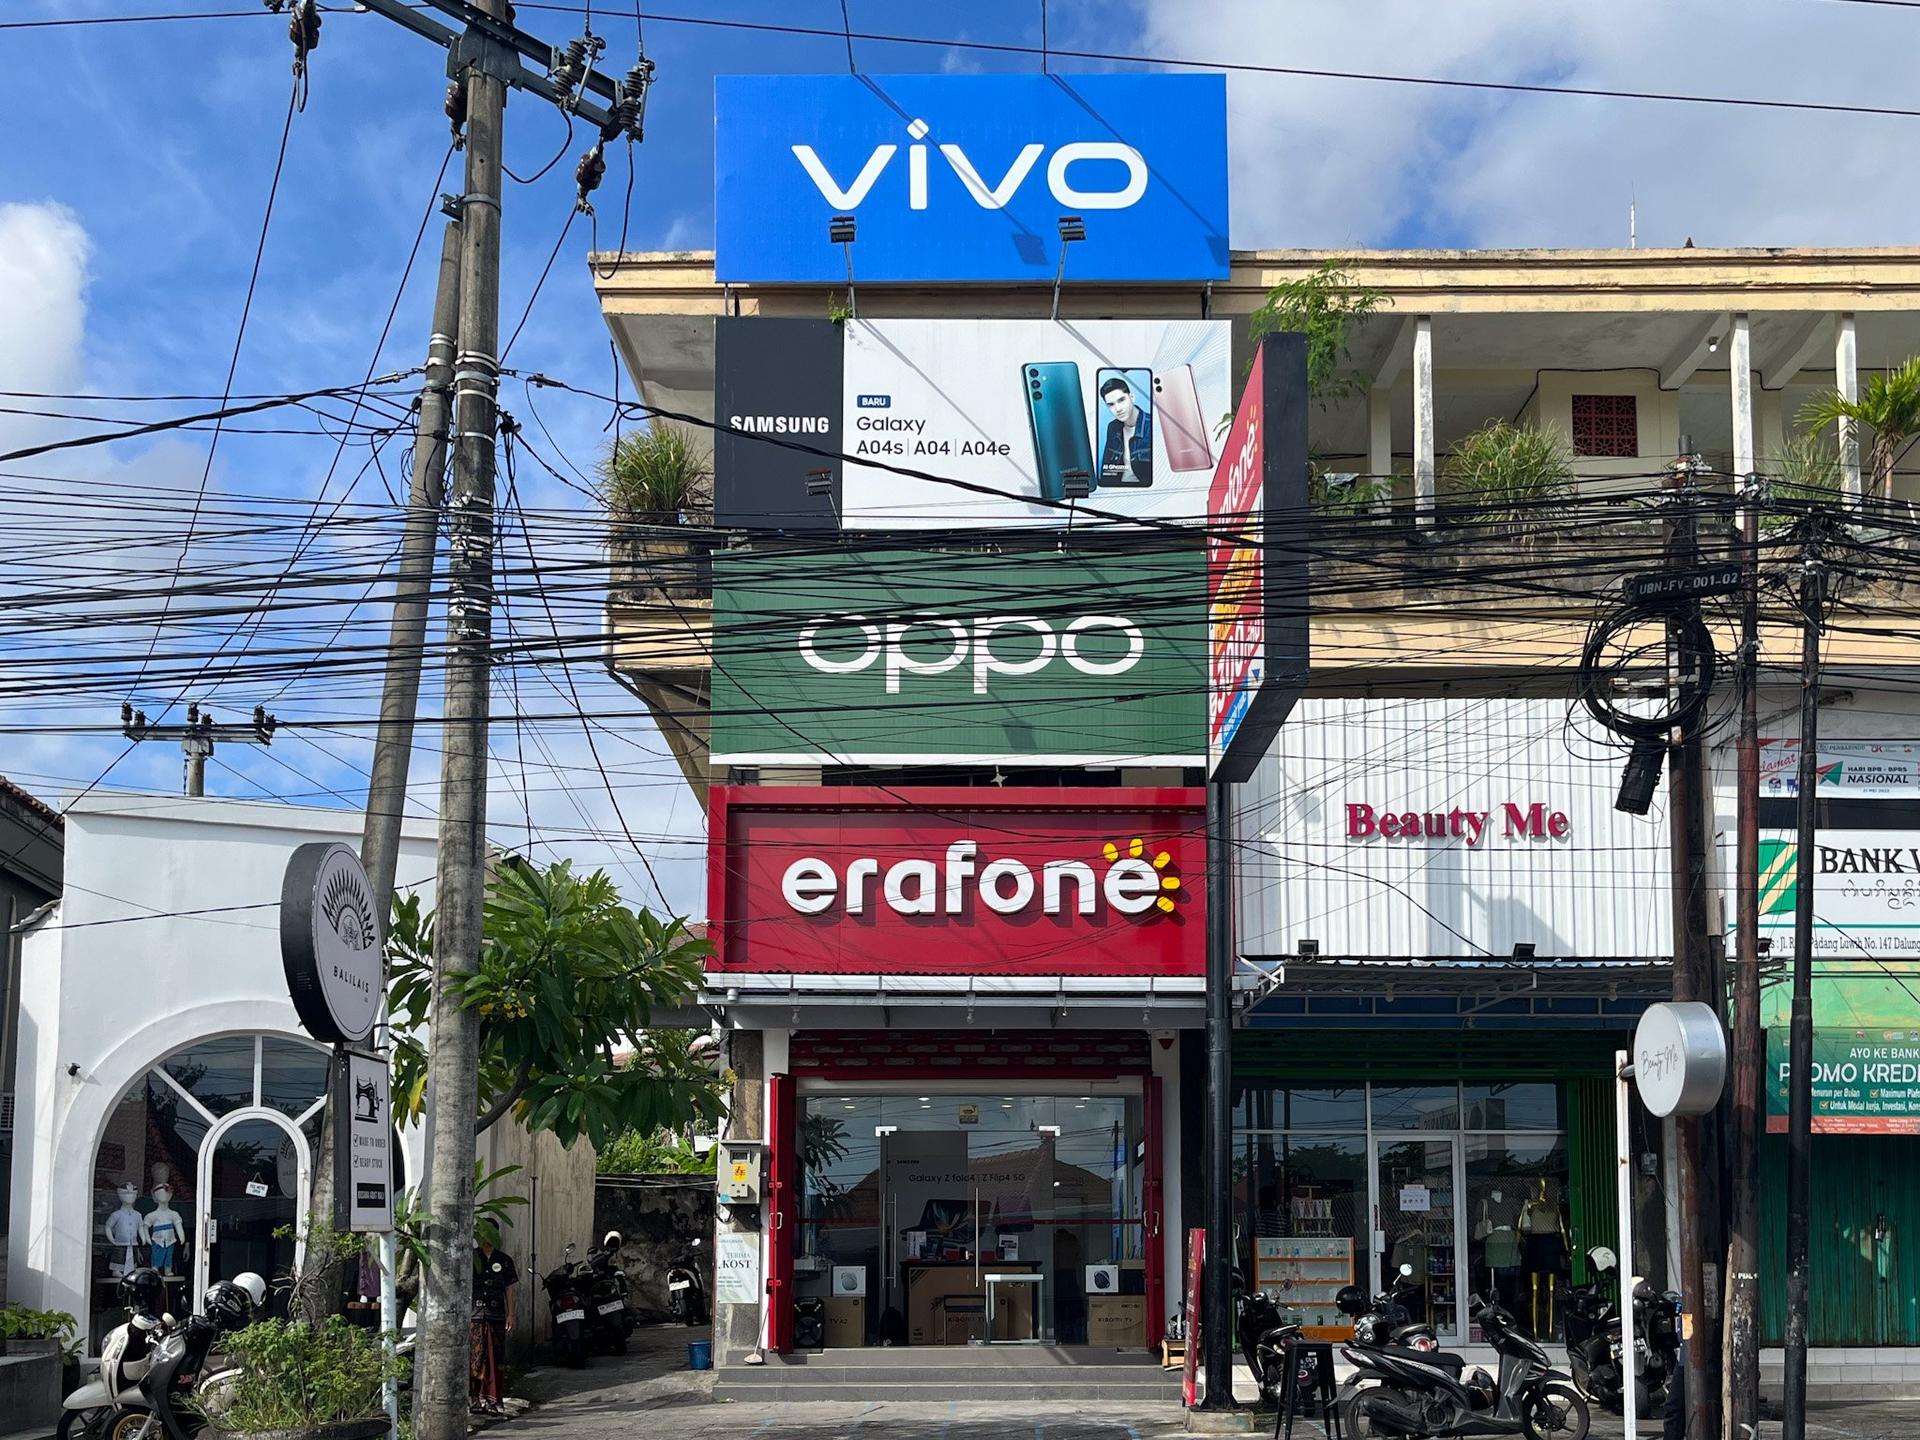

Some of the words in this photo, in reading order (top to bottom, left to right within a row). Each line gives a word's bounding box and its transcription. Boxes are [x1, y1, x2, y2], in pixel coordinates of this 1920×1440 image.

[791, 117, 1149, 211] vivo
[861, 397, 886, 407] BARU
[730, 415, 830, 433] SAMSUNG
[856, 416, 926, 435] Galaxy
[856, 440, 904, 455] A04s
[914, 440, 950, 455] A04
[961, 441, 1011, 456] A04e
[798, 611, 1144, 695] oppo
[1847, 775, 1909, 784] NASIONAL
[1344, 803, 1488, 846] Beauty
[1502, 803, 1568, 839] Me
[1820, 848, 1904, 873] BANK
[781, 839, 1162, 917] erafone
[1865, 938, 1878, 950] No.
[1879, 937, 1892, 950] 147
[333, 965, 369, 993] BALILAIS
[1850, 1048, 1871, 1059] AYO
[1874, 1048, 1888, 1059] KE
[1891, 1048, 1920, 1059] BANK
[1779, 1062, 1858, 1083] POMO
[1829, 1101, 1847, 1111] Untuk
[908, 1174, 942, 1185] Galaxy
[722, 1259, 752, 1269] KOST
